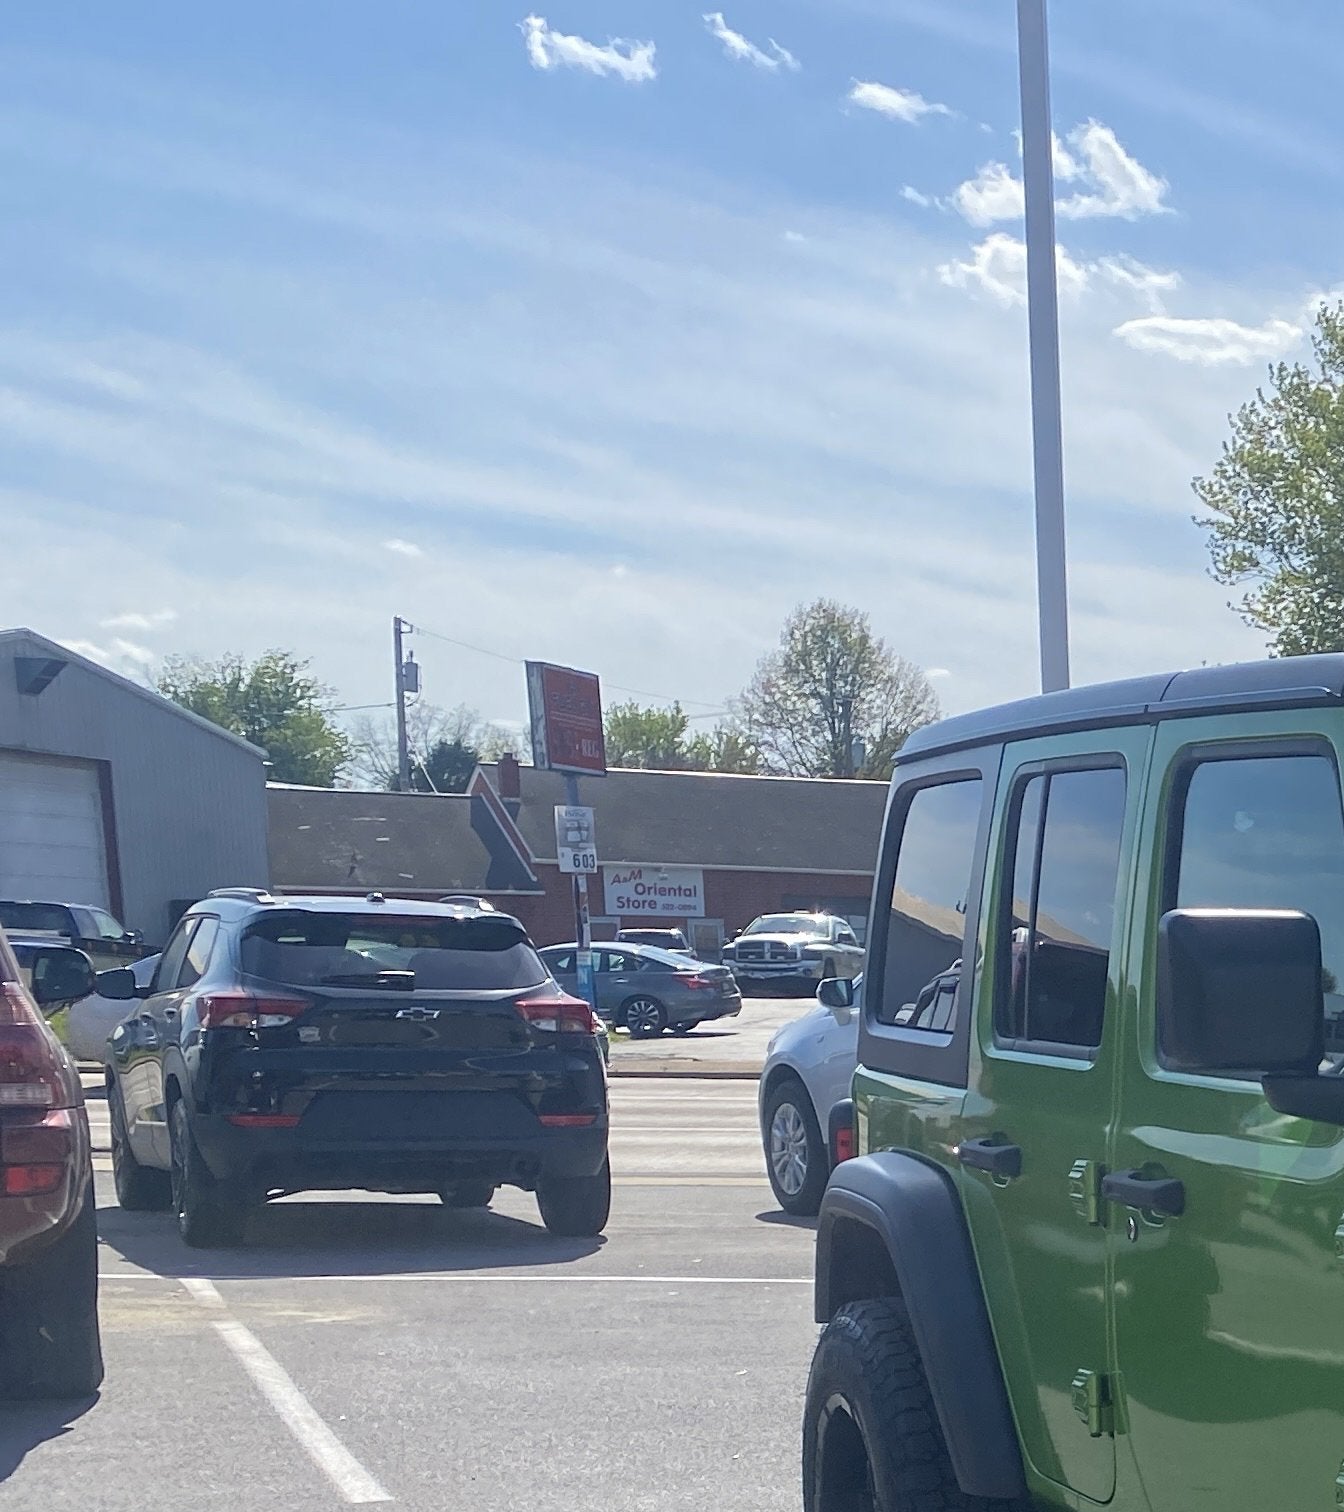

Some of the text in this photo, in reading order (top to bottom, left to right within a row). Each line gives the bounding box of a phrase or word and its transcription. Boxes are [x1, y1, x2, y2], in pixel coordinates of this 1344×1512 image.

[572, 853, 595, 869] 603
[634, 882, 697, 898] Oriental
[616, 896, 657, 910] Store
